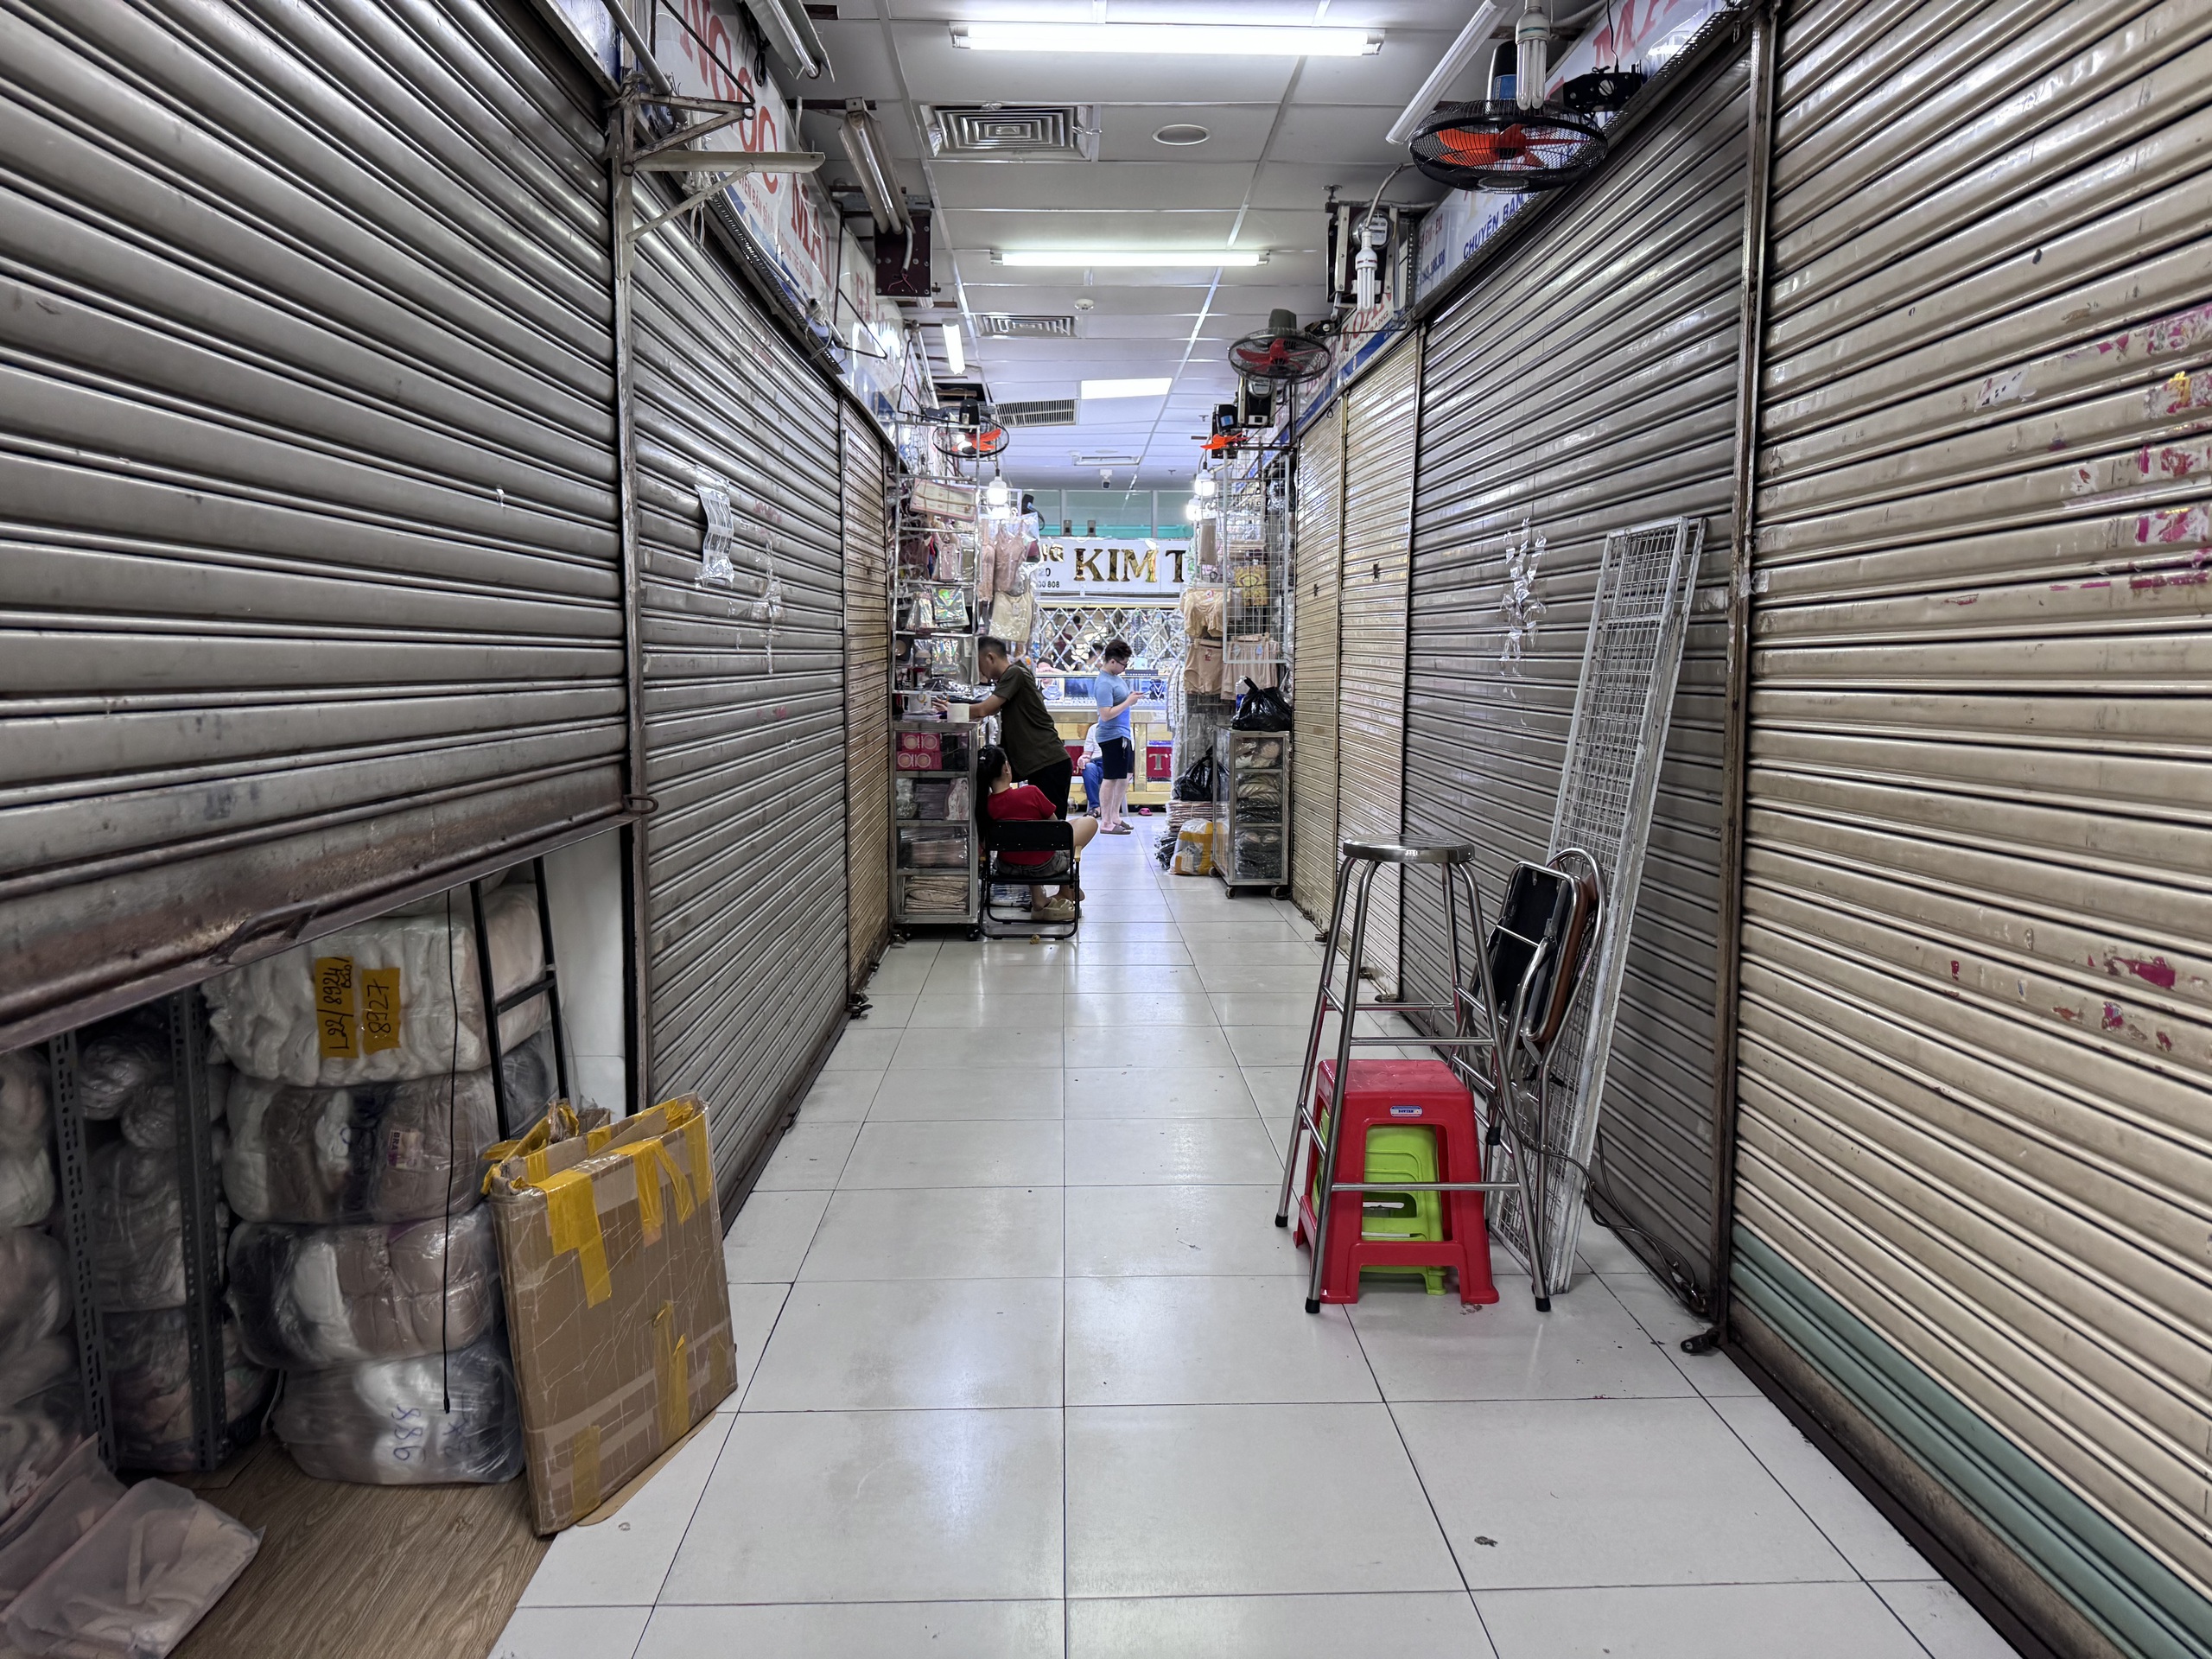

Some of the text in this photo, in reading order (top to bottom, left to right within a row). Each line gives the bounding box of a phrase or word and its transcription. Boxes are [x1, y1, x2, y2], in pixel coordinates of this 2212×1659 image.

[1463, 211, 1500, 259] CHUYÊN
[1074, 548, 1159, 583] KIM
[366, 978, 391, 1033] 8927
